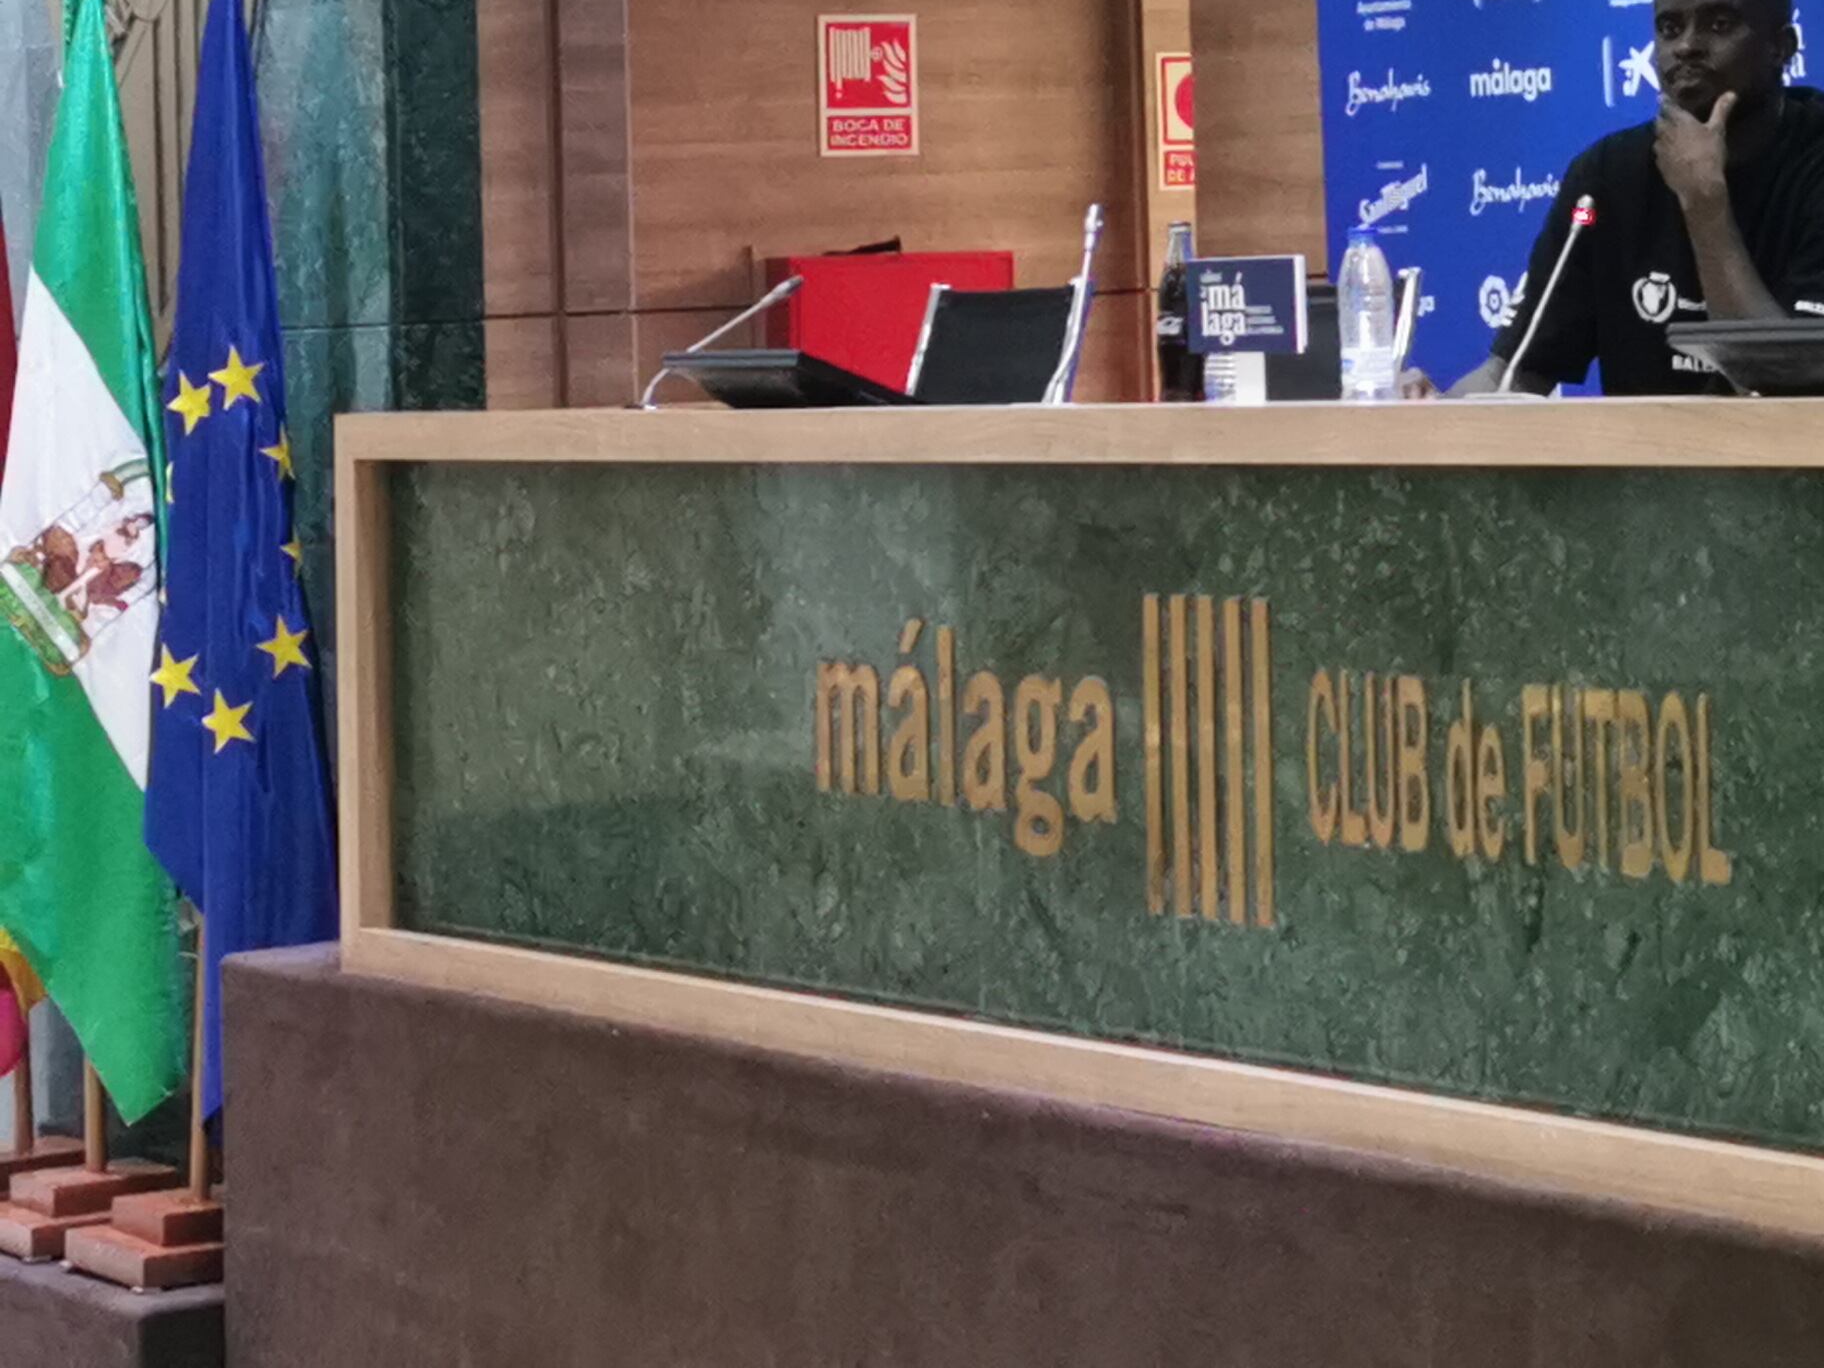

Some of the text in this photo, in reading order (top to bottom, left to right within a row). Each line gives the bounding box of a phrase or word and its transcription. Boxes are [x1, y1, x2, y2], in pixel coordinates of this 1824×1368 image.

[832, 118, 905, 133] BOCA DE
[816, 617, 1732, 885] málaga CLUB de FUTBOL
